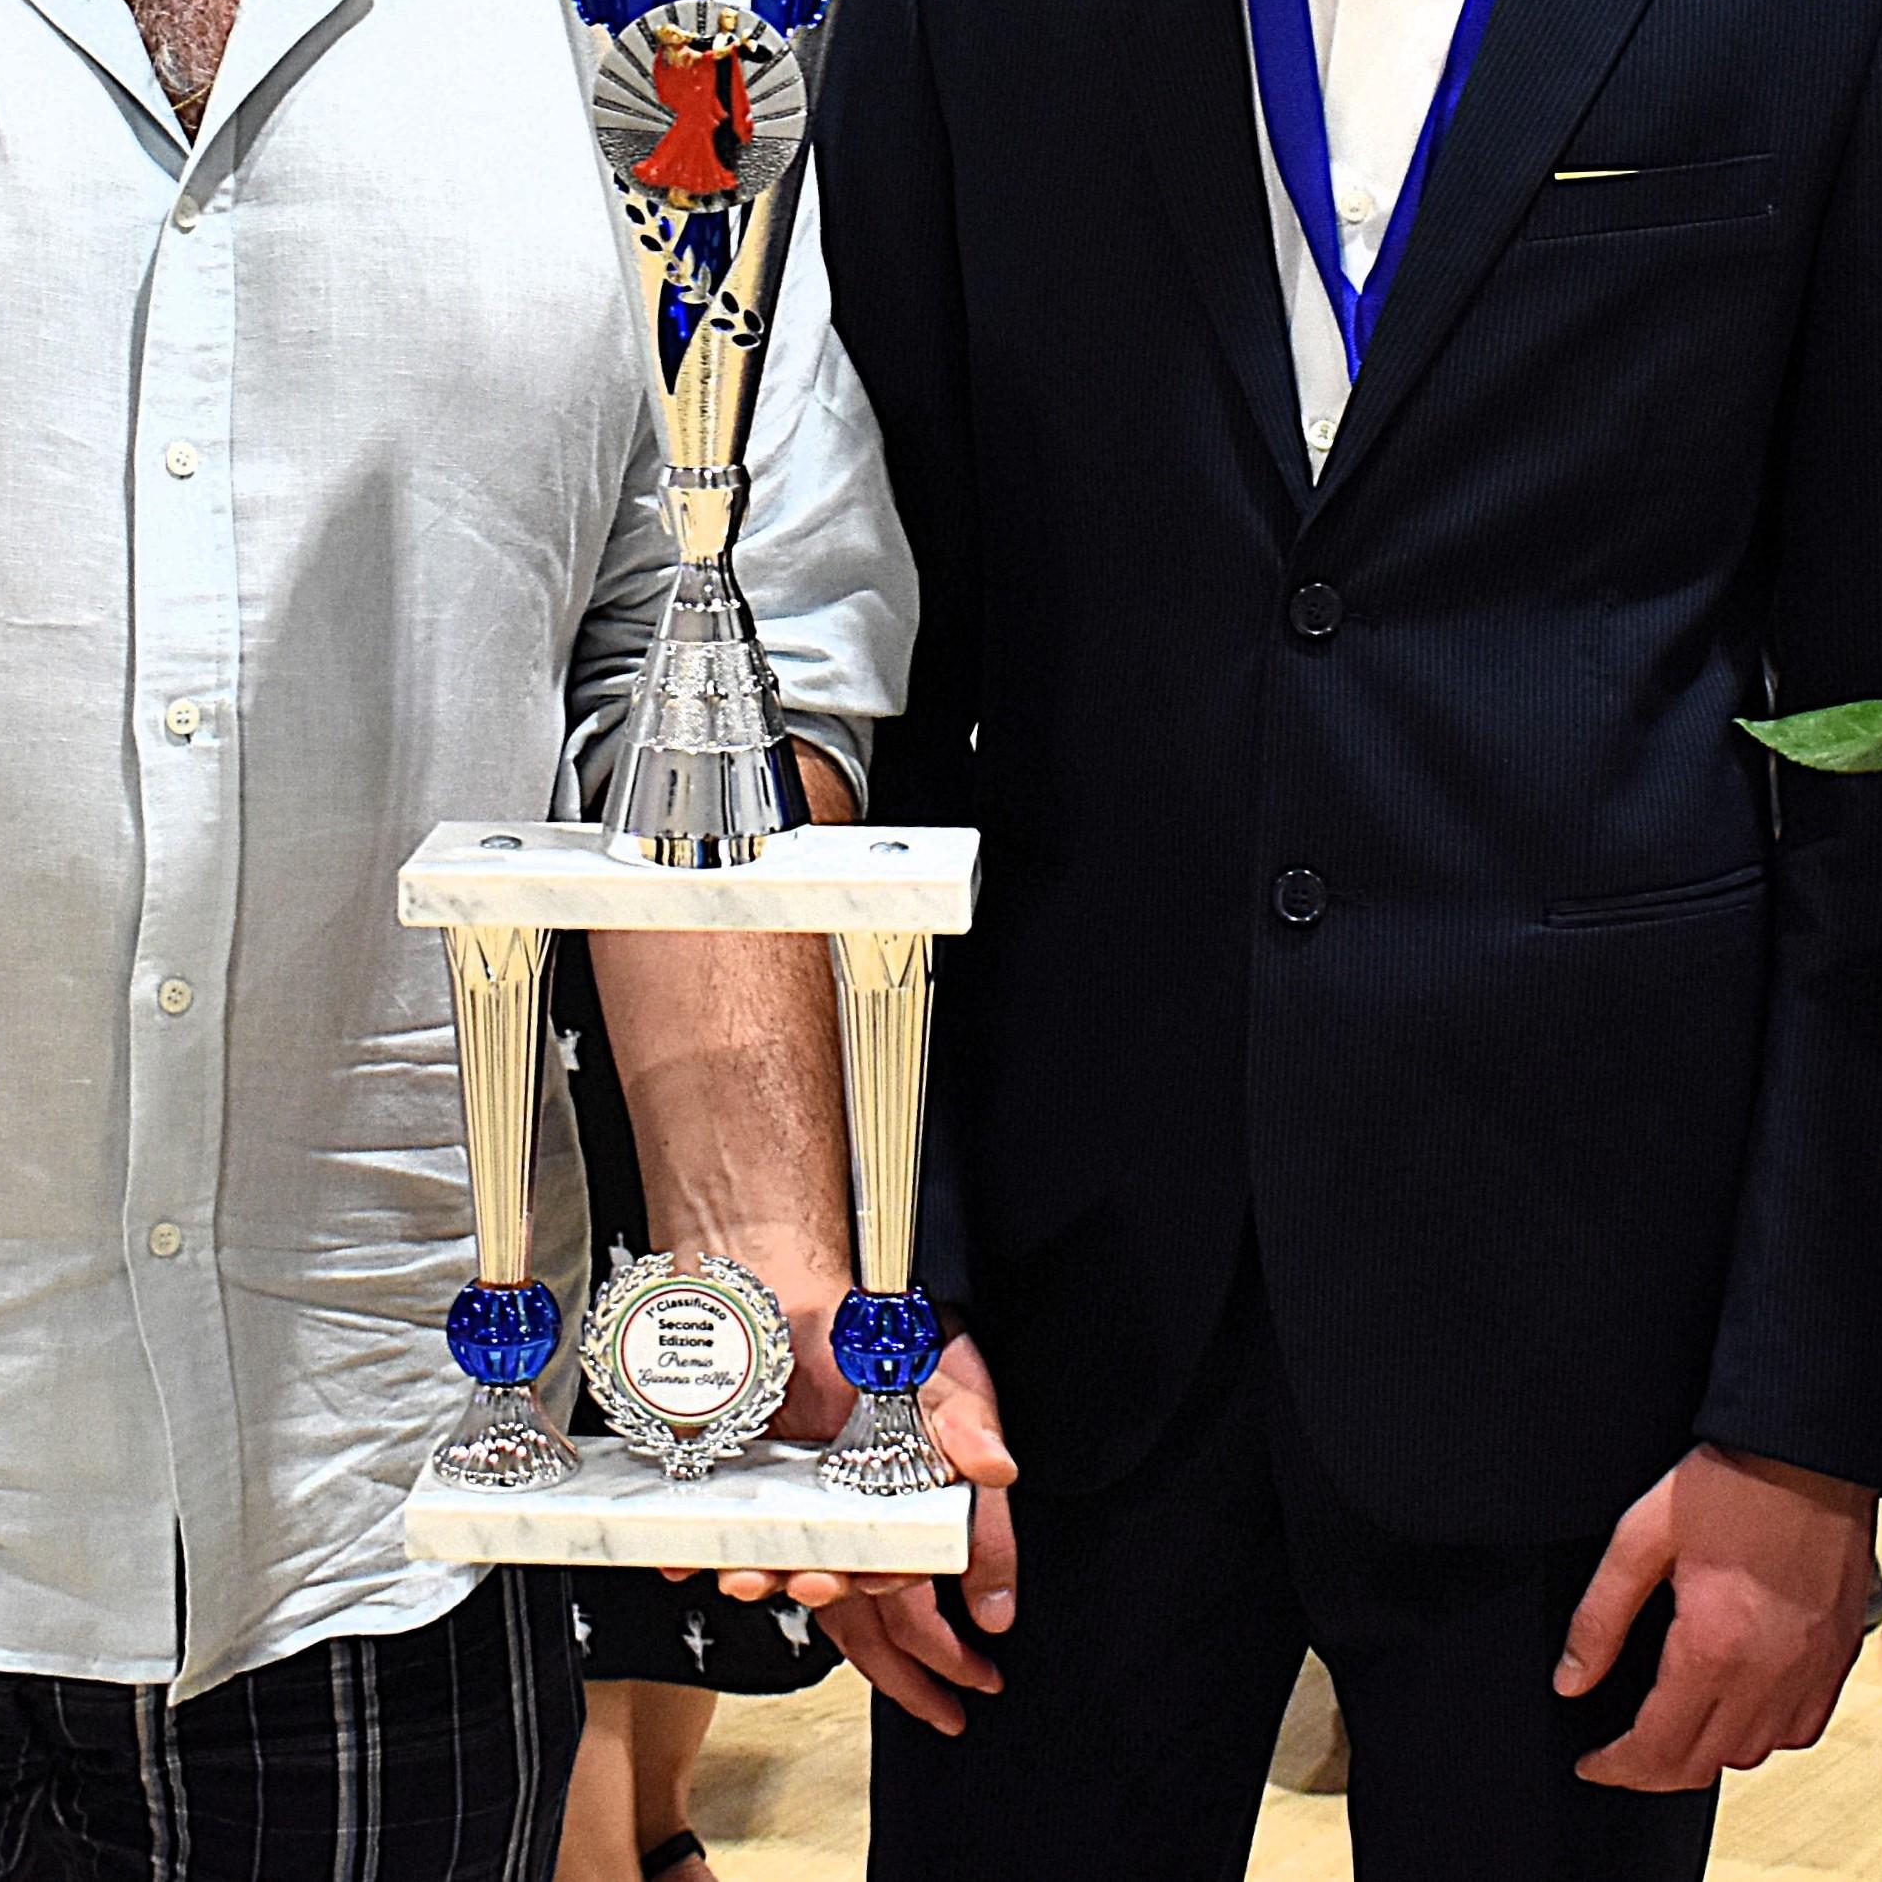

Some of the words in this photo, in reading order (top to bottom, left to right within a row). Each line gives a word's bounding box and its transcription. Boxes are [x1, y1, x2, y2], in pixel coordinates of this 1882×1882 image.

[656, 1297, 727, 1321] Classificato
[658, 1318, 714, 1331] Seconda
[658, 1334, 714, 1348] Edizione
[658, 1350, 713, 1368] Premio
